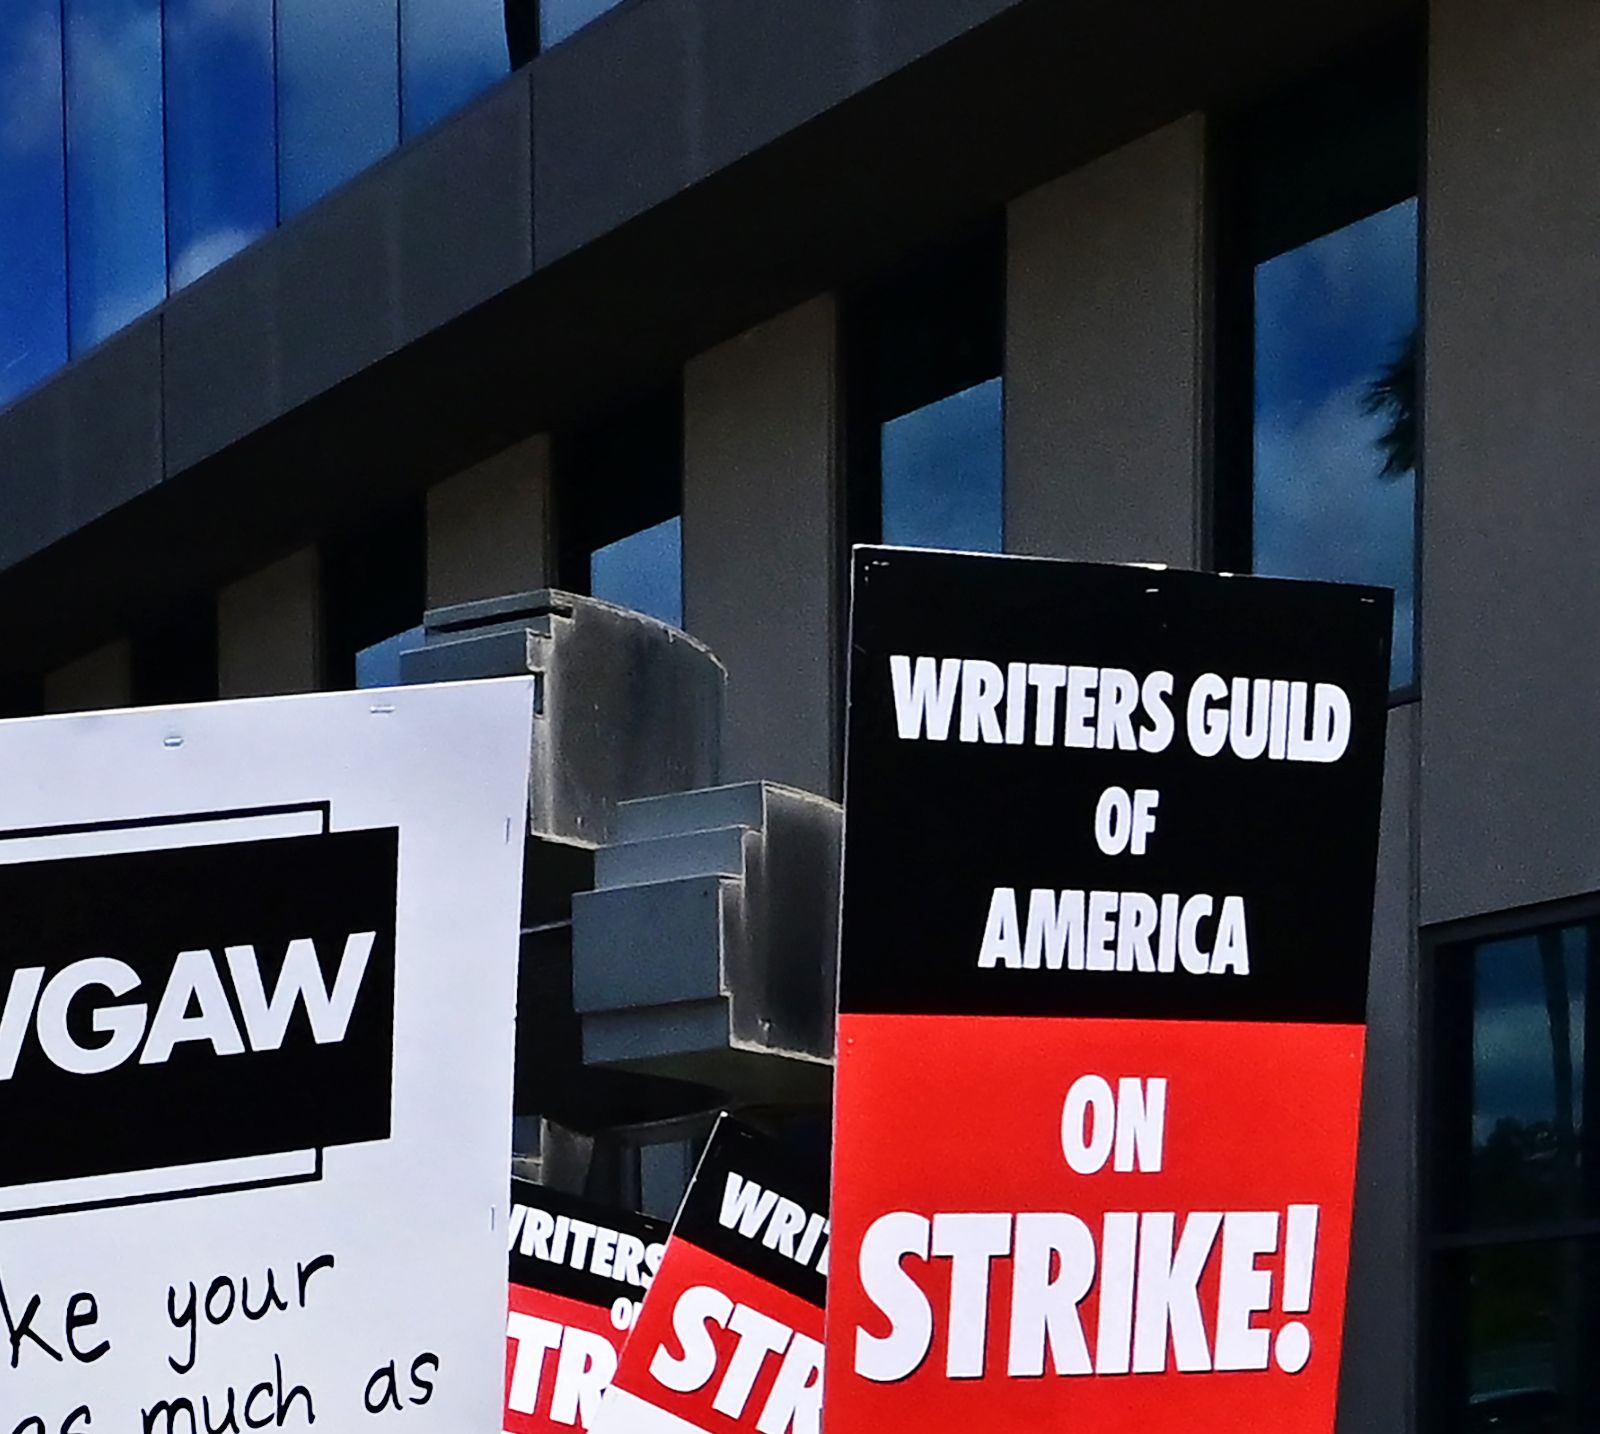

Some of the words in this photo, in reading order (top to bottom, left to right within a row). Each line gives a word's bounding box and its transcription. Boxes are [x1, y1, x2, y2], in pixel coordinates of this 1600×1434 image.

[890, 656, 1174, 753] WRITERS
[1186, 672, 1350, 763] GUILD
[1094, 786, 1160, 856] OF
[978, 887, 1250, 976] AMERICA
[1061, 1074, 1167, 1175] ON
[167, 1253, 335, 1375] your
[854, 1204, 1320, 1382] STRIKE!
[364, 1351, 440, 1414] as
